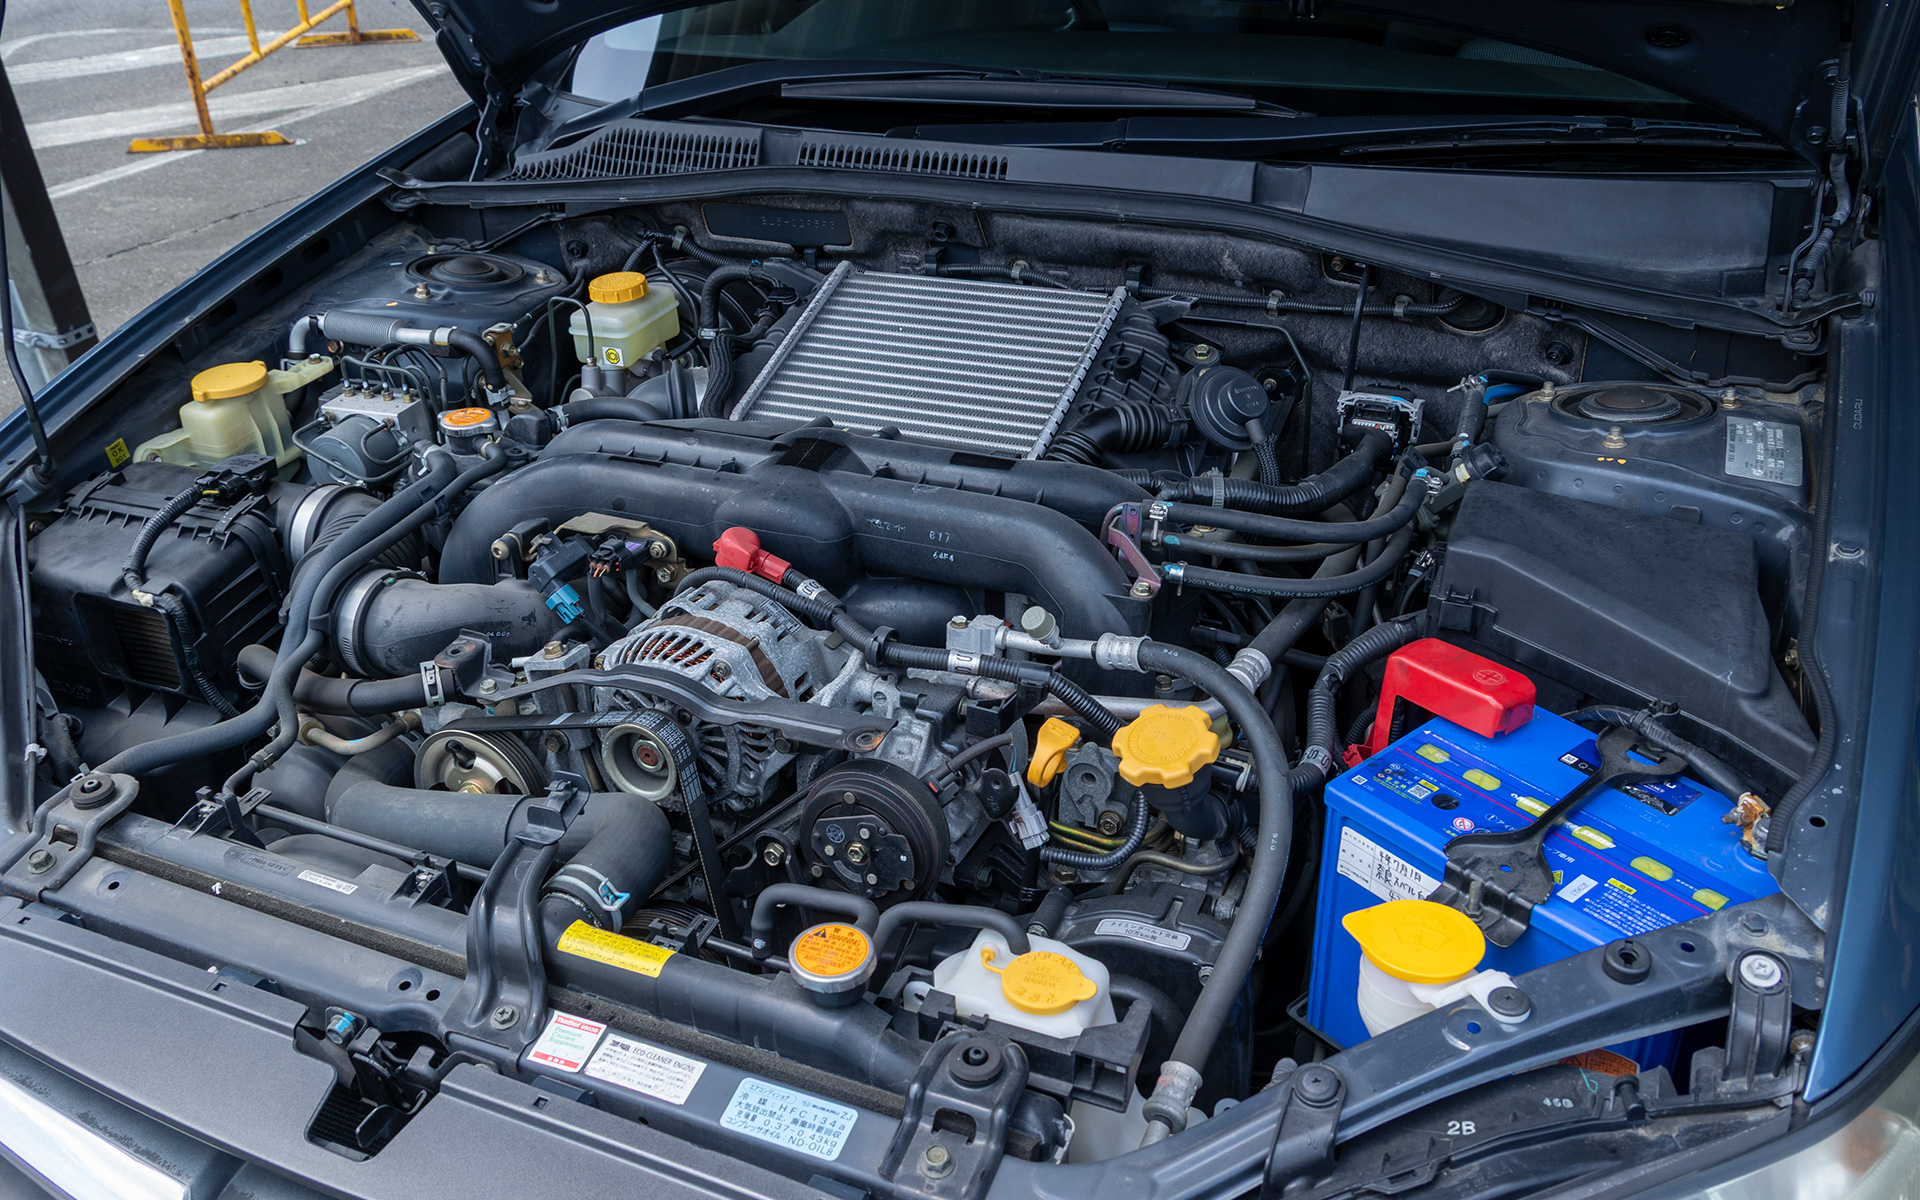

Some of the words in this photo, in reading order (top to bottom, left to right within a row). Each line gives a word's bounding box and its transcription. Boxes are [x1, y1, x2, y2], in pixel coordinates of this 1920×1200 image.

[1853, 398, 1863, 430] SUBARU
[632, 1046, 674, 1066] ECO-CLEANER
[672, 1058, 697, 1074] ENGINE
[811, 1104, 841, 1116] SUBARU
[840, 1111, 854, 1122] ZJ
[1446, 1120, 1477, 1136] 2B
